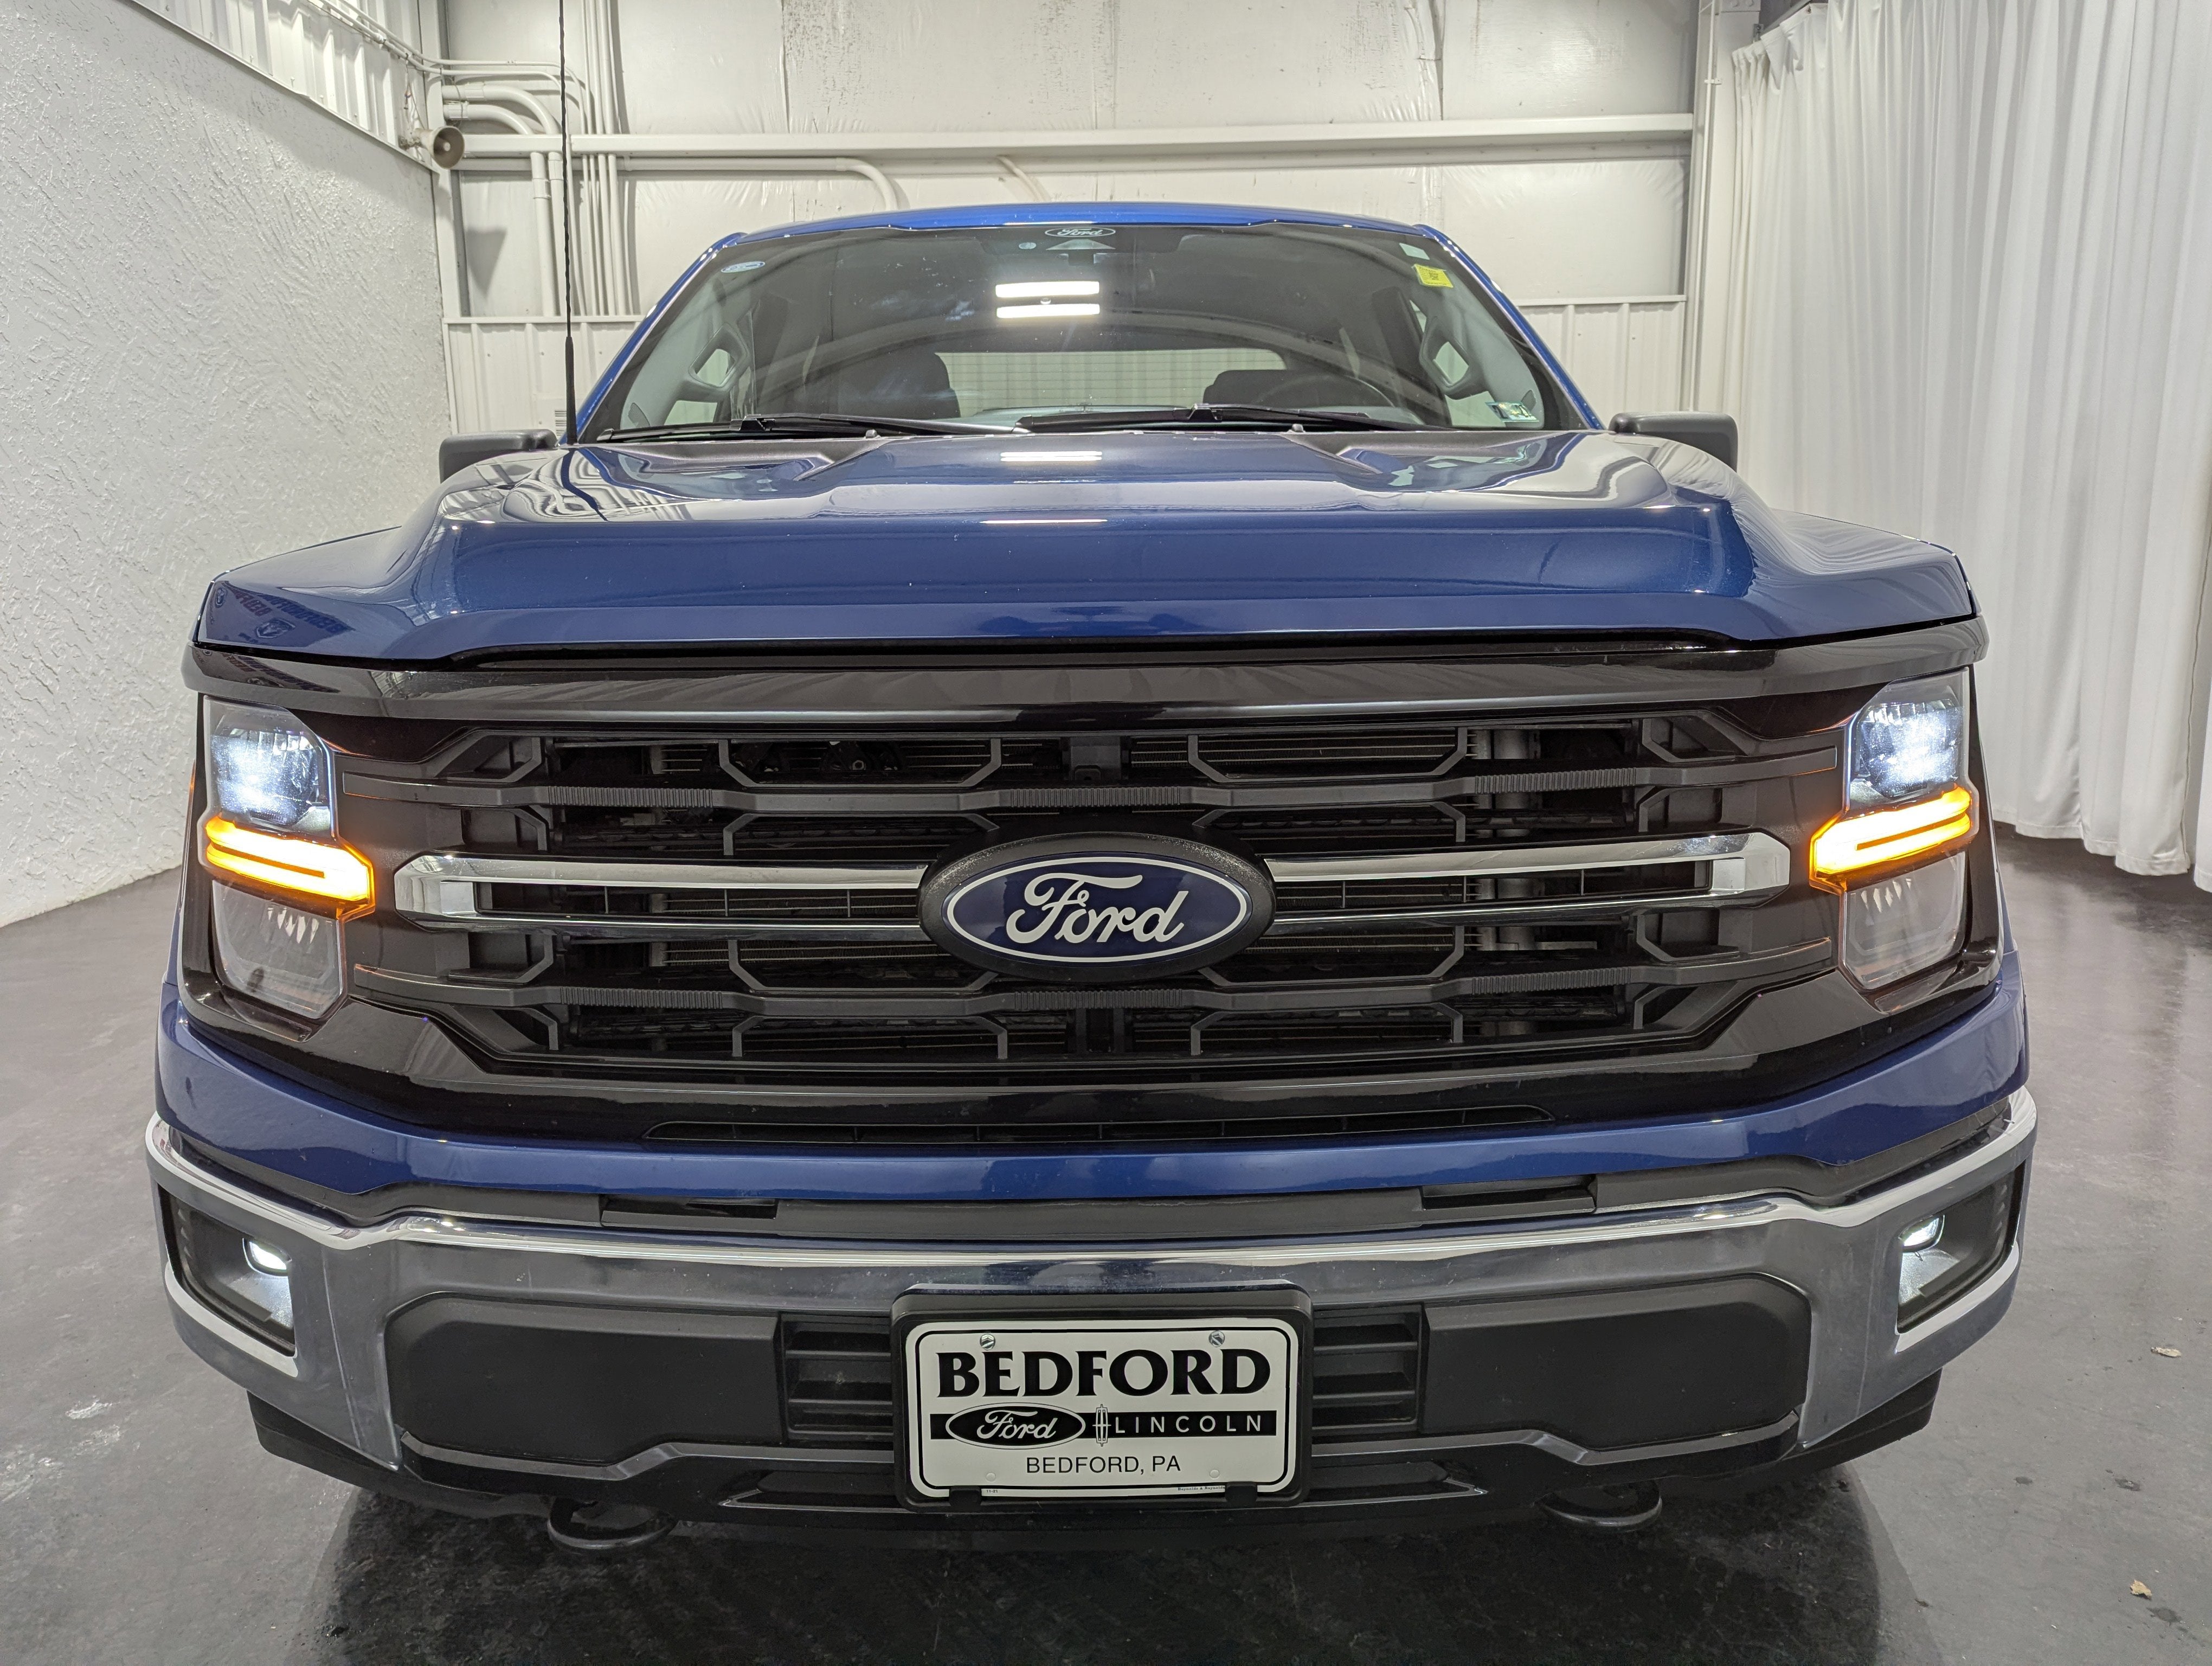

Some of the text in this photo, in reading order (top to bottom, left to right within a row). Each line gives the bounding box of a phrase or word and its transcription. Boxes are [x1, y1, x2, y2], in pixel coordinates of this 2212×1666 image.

[1006, 873, 1189, 944] Ford
[936, 1349, 1271, 1398] BEDFORD
[976, 1410, 1056, 1439] Ford
[1115, 1415, 1261, 1433] LINCOLN
[1027, 1455, 1181, 1475] BEDFORD, PA
